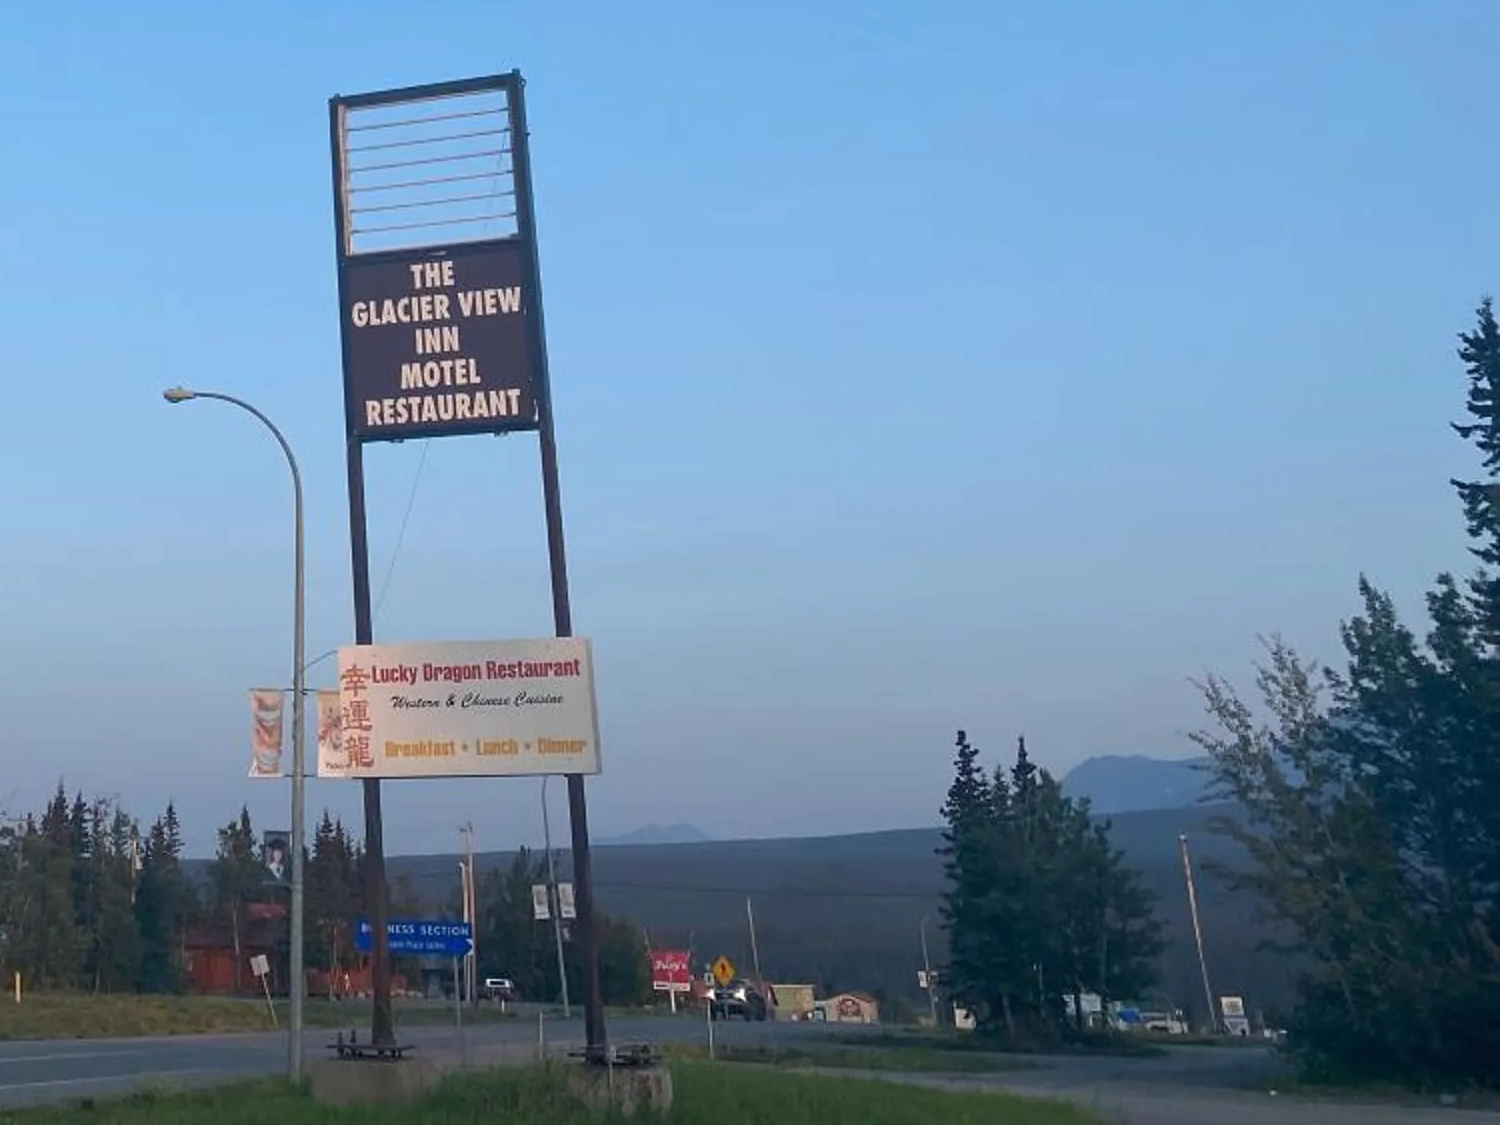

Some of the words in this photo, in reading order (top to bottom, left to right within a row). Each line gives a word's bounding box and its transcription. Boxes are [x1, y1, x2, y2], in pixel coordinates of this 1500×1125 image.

[410, 260, 455, 290] THE
[352, 293, 451, 327] GLACIER
[457, 286, 521, 318] VIEW
[415, 326, 460, 355] INN
[400, 358, 482, 390] MOTEL
[365, 388, 521, 427] RESTAURANT
[372, 663, 417, 686] Lucky
[423, 662, 482, 683] Dragon
[486, 658, 580, 680] Restaurant
[390, 695, 440, 709] Western
[445, 693, 456, 708] &
[461, 691, 510, 708] Chinese
[514, 691, 563, 707] Cuisine
[385, 740, 454, 757] Breakfast
[476, 738, 519, 755] Lunch
[538, 737, 587, 755] Dinner
[420, 925, 469, 936] SECTION
